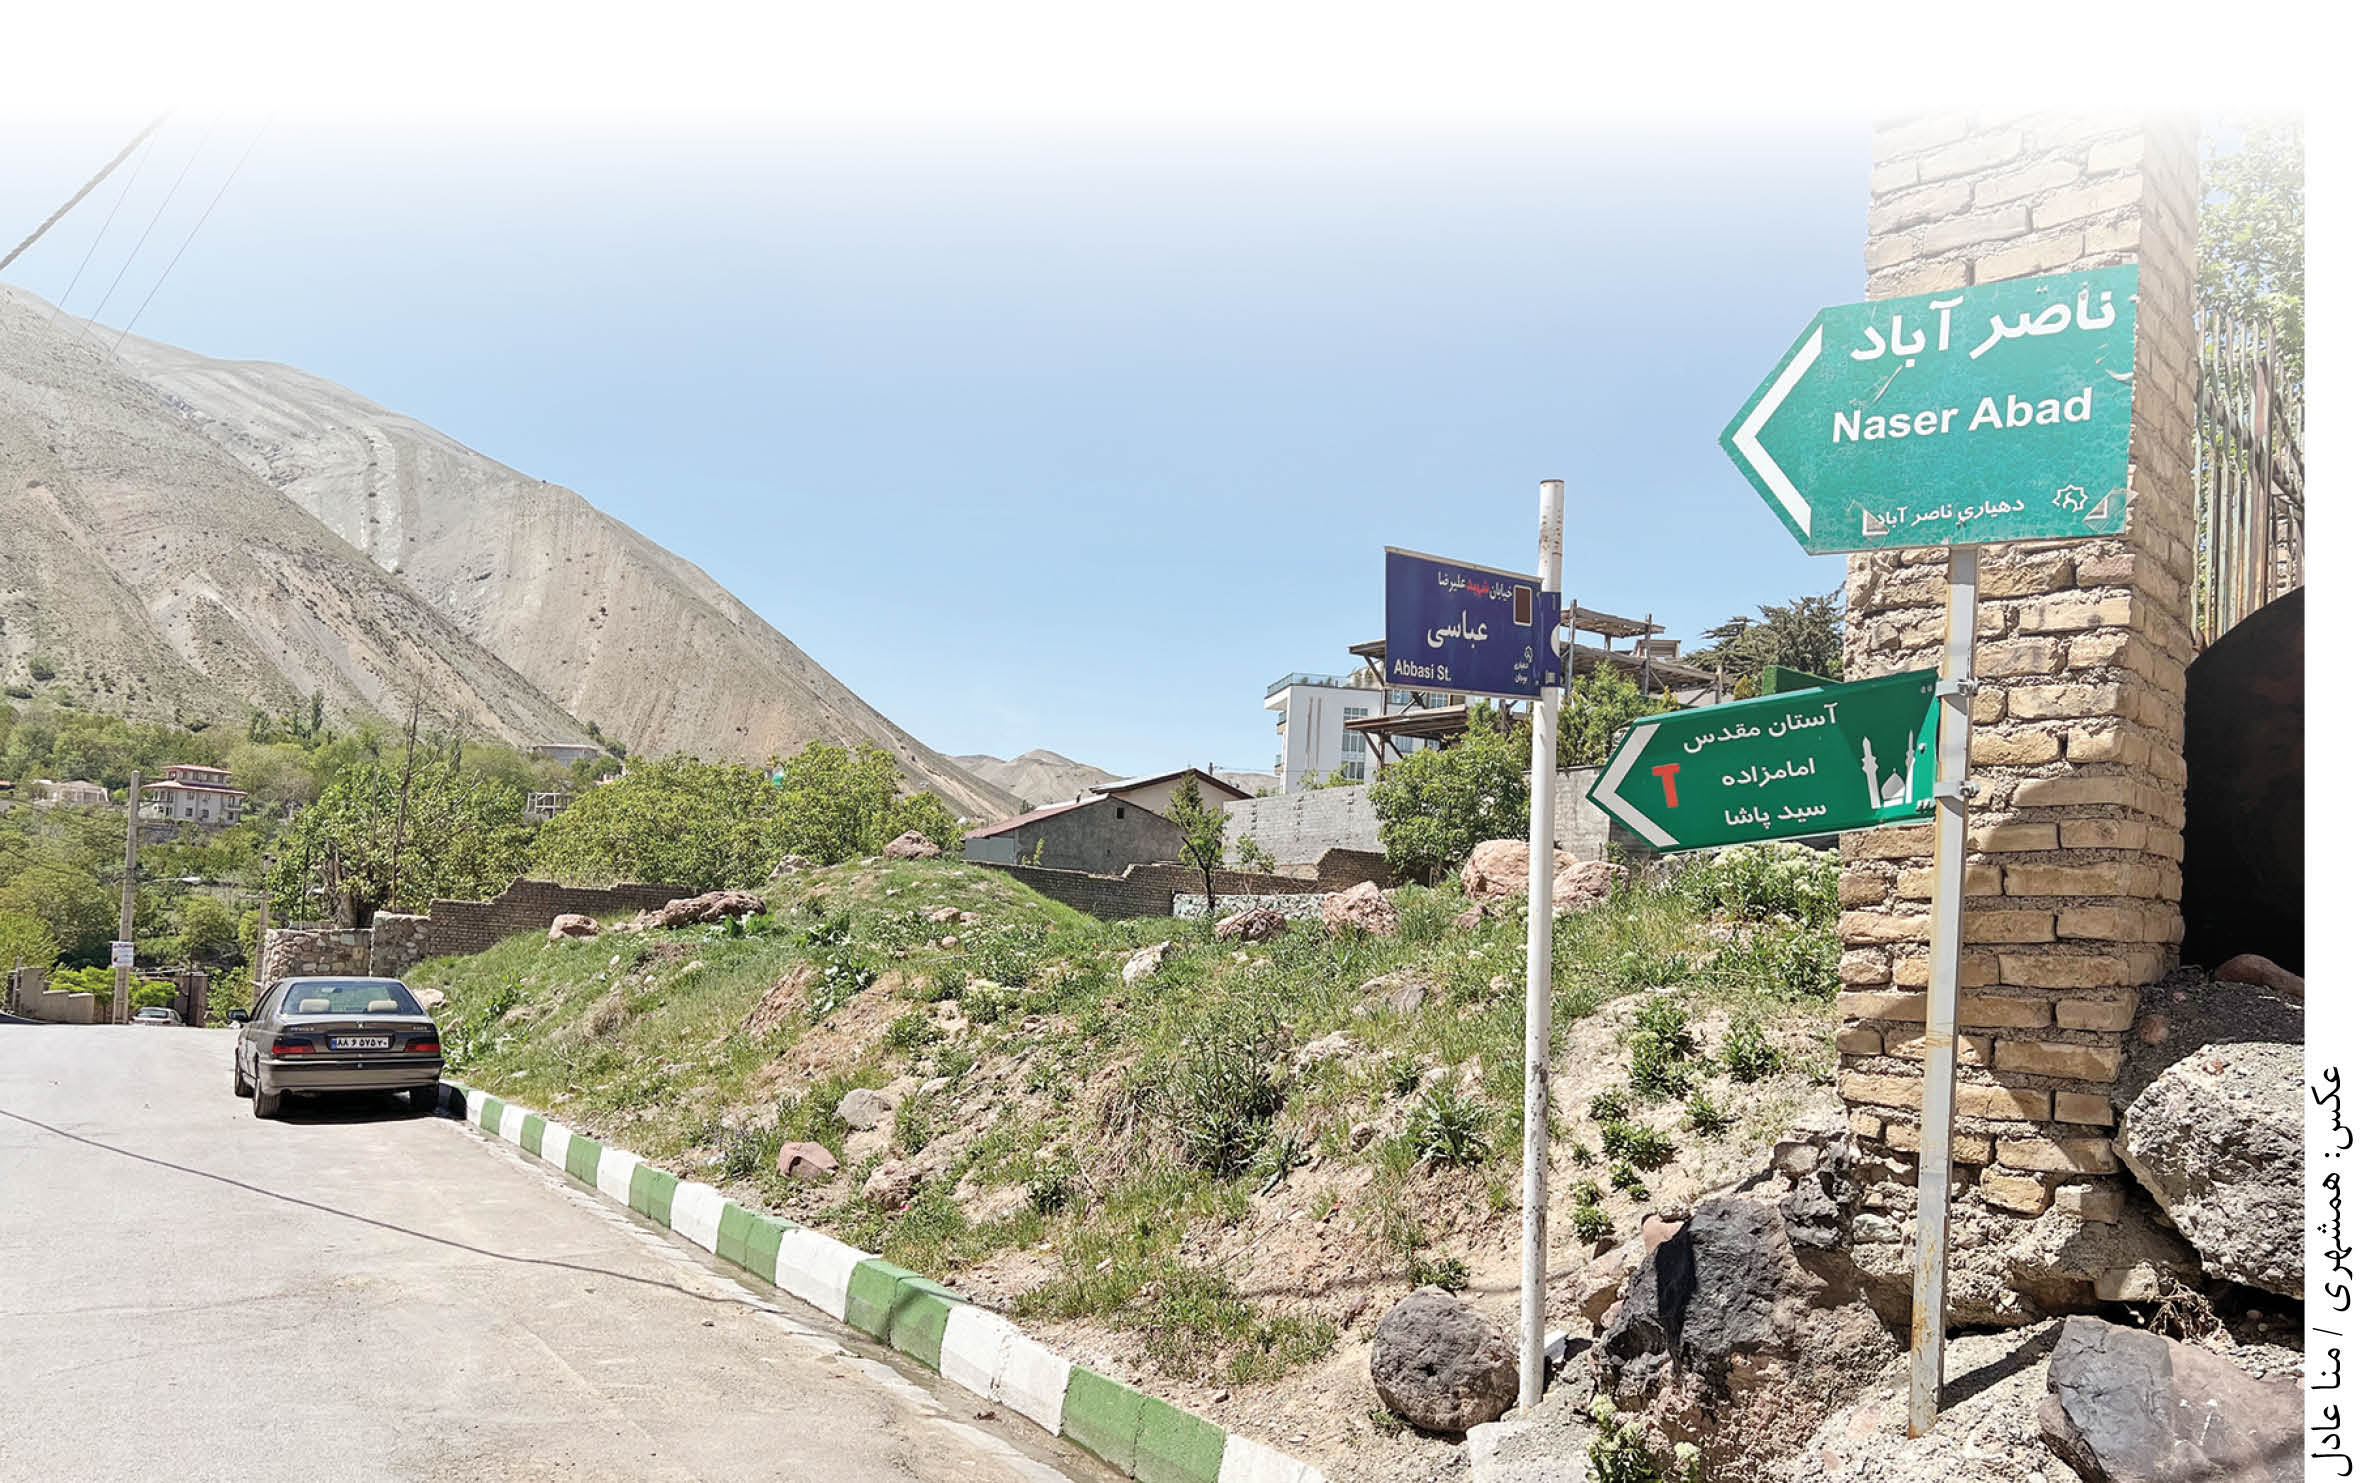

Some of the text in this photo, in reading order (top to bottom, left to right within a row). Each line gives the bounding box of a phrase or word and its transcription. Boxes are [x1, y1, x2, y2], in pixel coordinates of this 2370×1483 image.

[1850, 288, 2116, 368] ناصر آباد
[1832, 386, 2092, 443] Naser Abad
[1876, 506, 1908, 528] آباد
[1911, 504, 1952, 526] ناصر
[1438, 571, 1513, 601] خیابان شهید علیرضا
[1427, 609, 1488, 648] عباسی
[1394, 658, 1452, 681] Abbasi St.
[1682, 701, 1839, 754] آستان مقدس
[1721, 757, 1816, 788] امامزاده
[1724, 802, 1828, 830] سید پاشا
